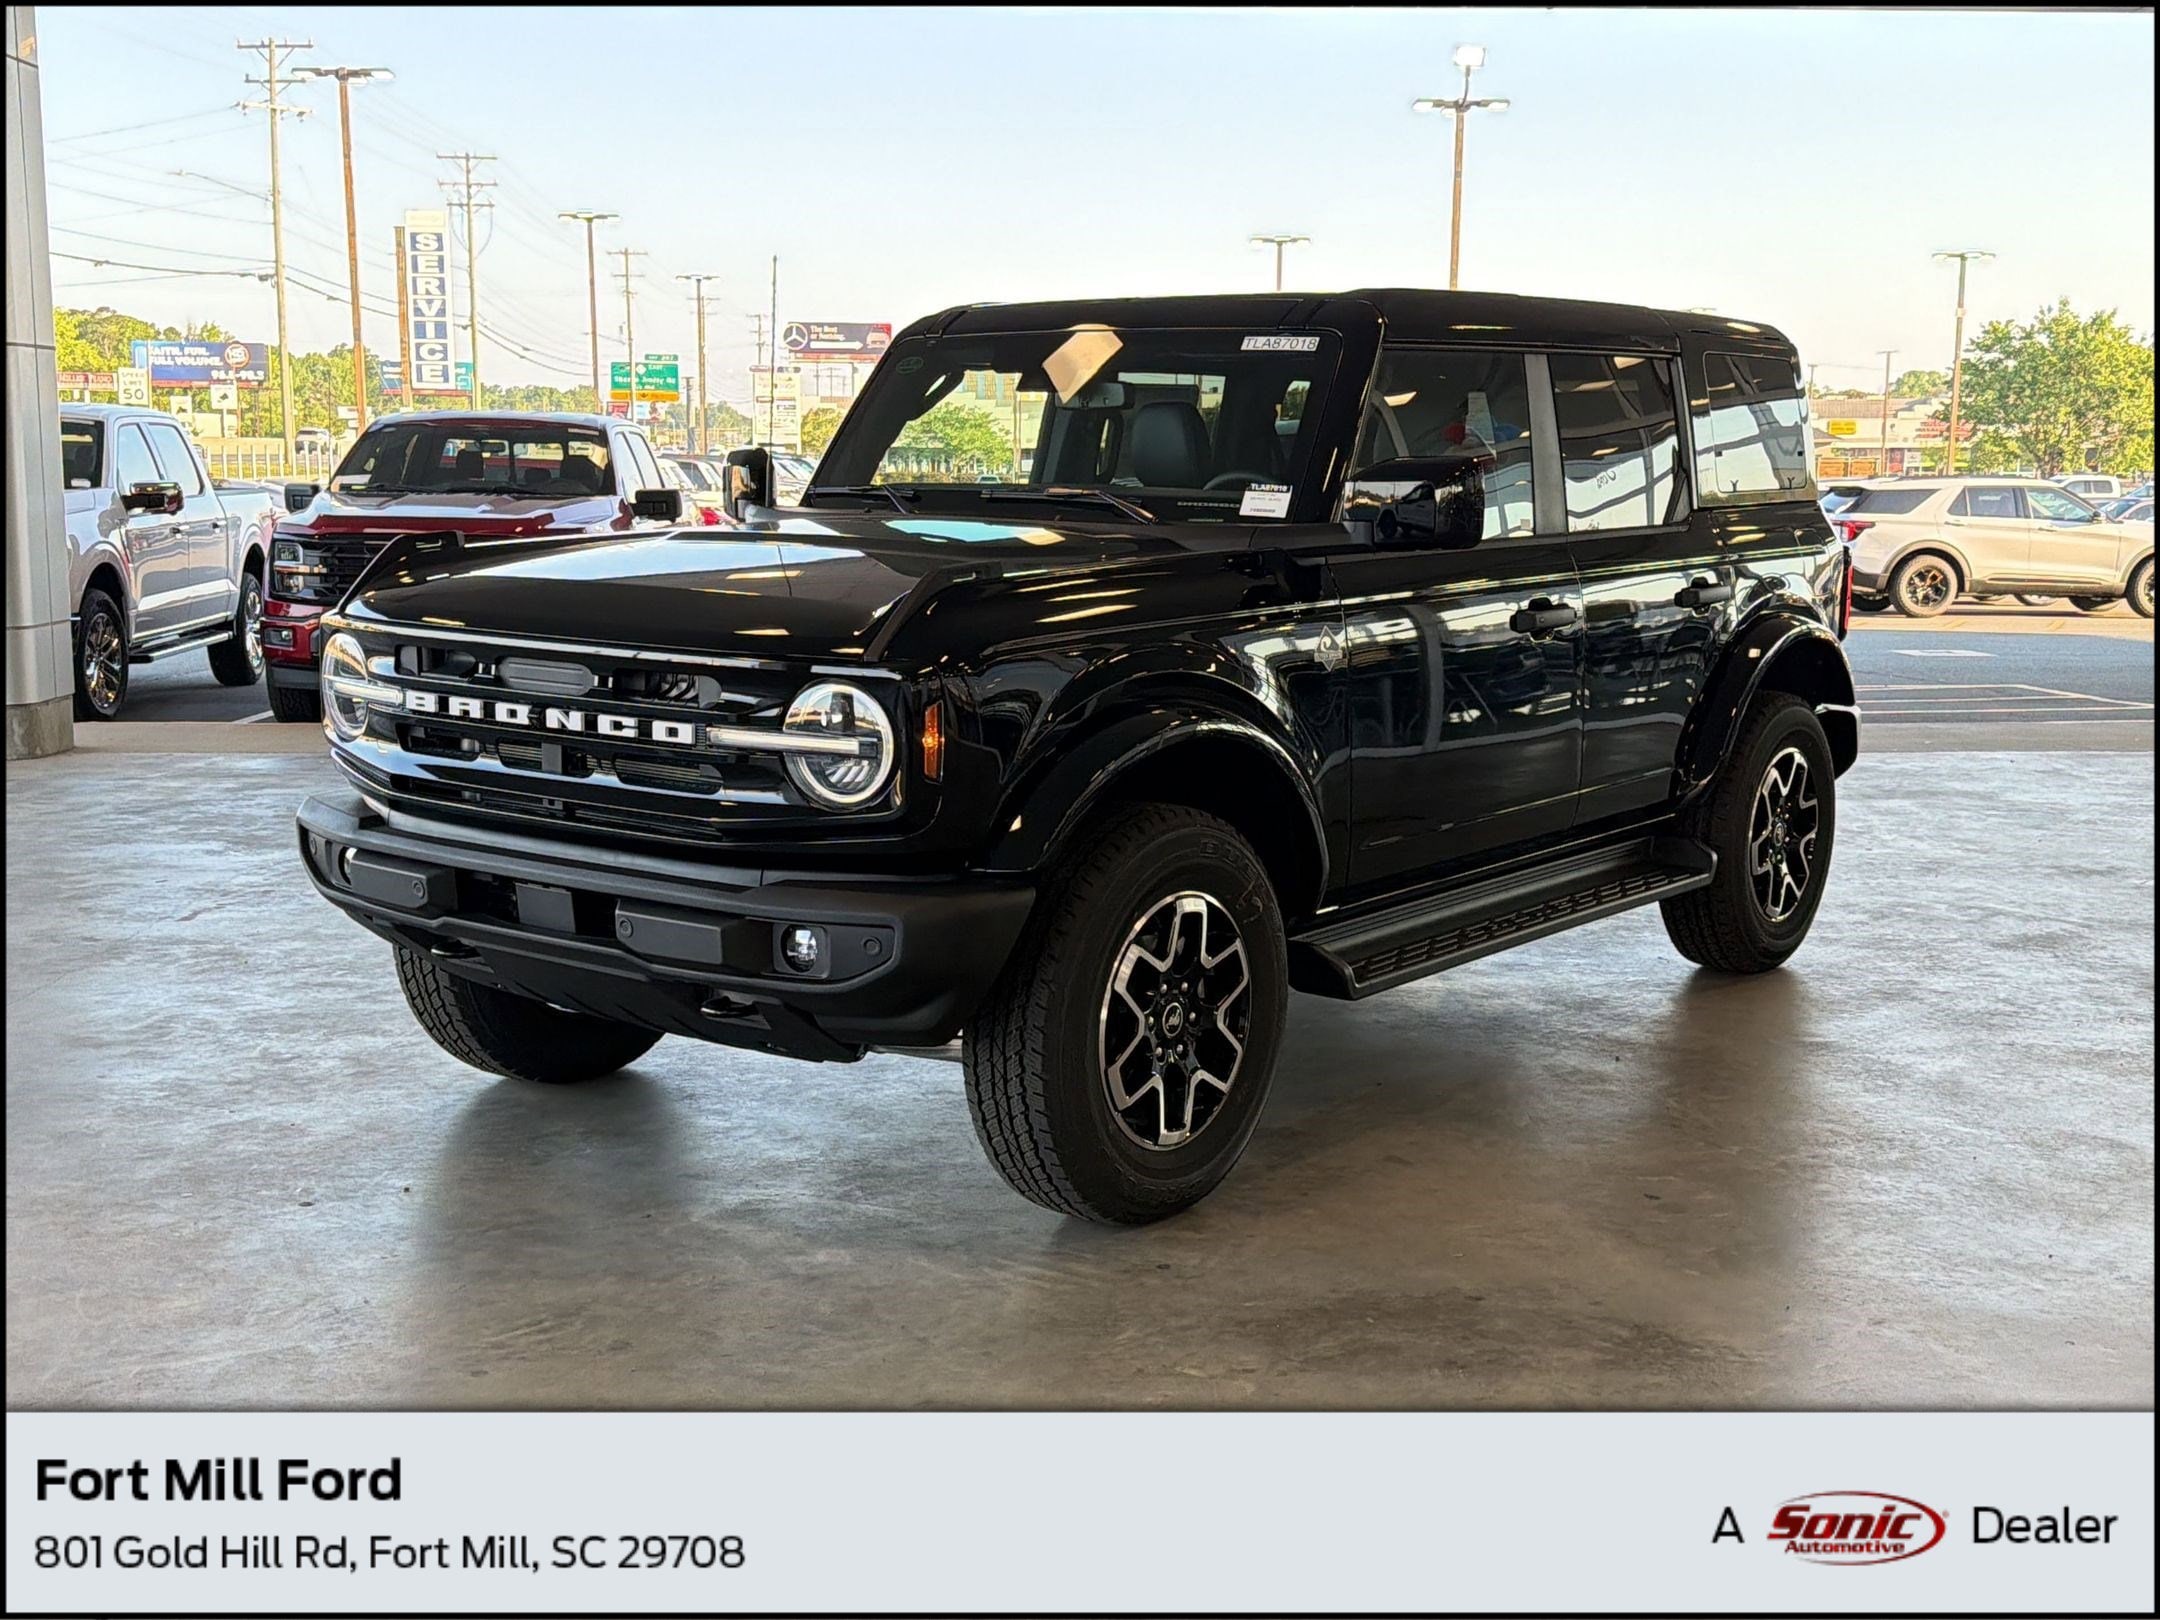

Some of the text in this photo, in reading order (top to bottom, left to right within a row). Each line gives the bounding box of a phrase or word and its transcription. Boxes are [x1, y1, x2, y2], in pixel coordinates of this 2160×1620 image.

[414, 233, 445, 383] SERVICE
[1244, 337, 1317, 350] TLA87018
[123, 388, 144, 400] 50
[405, 690, 697, 745] BRONCO
